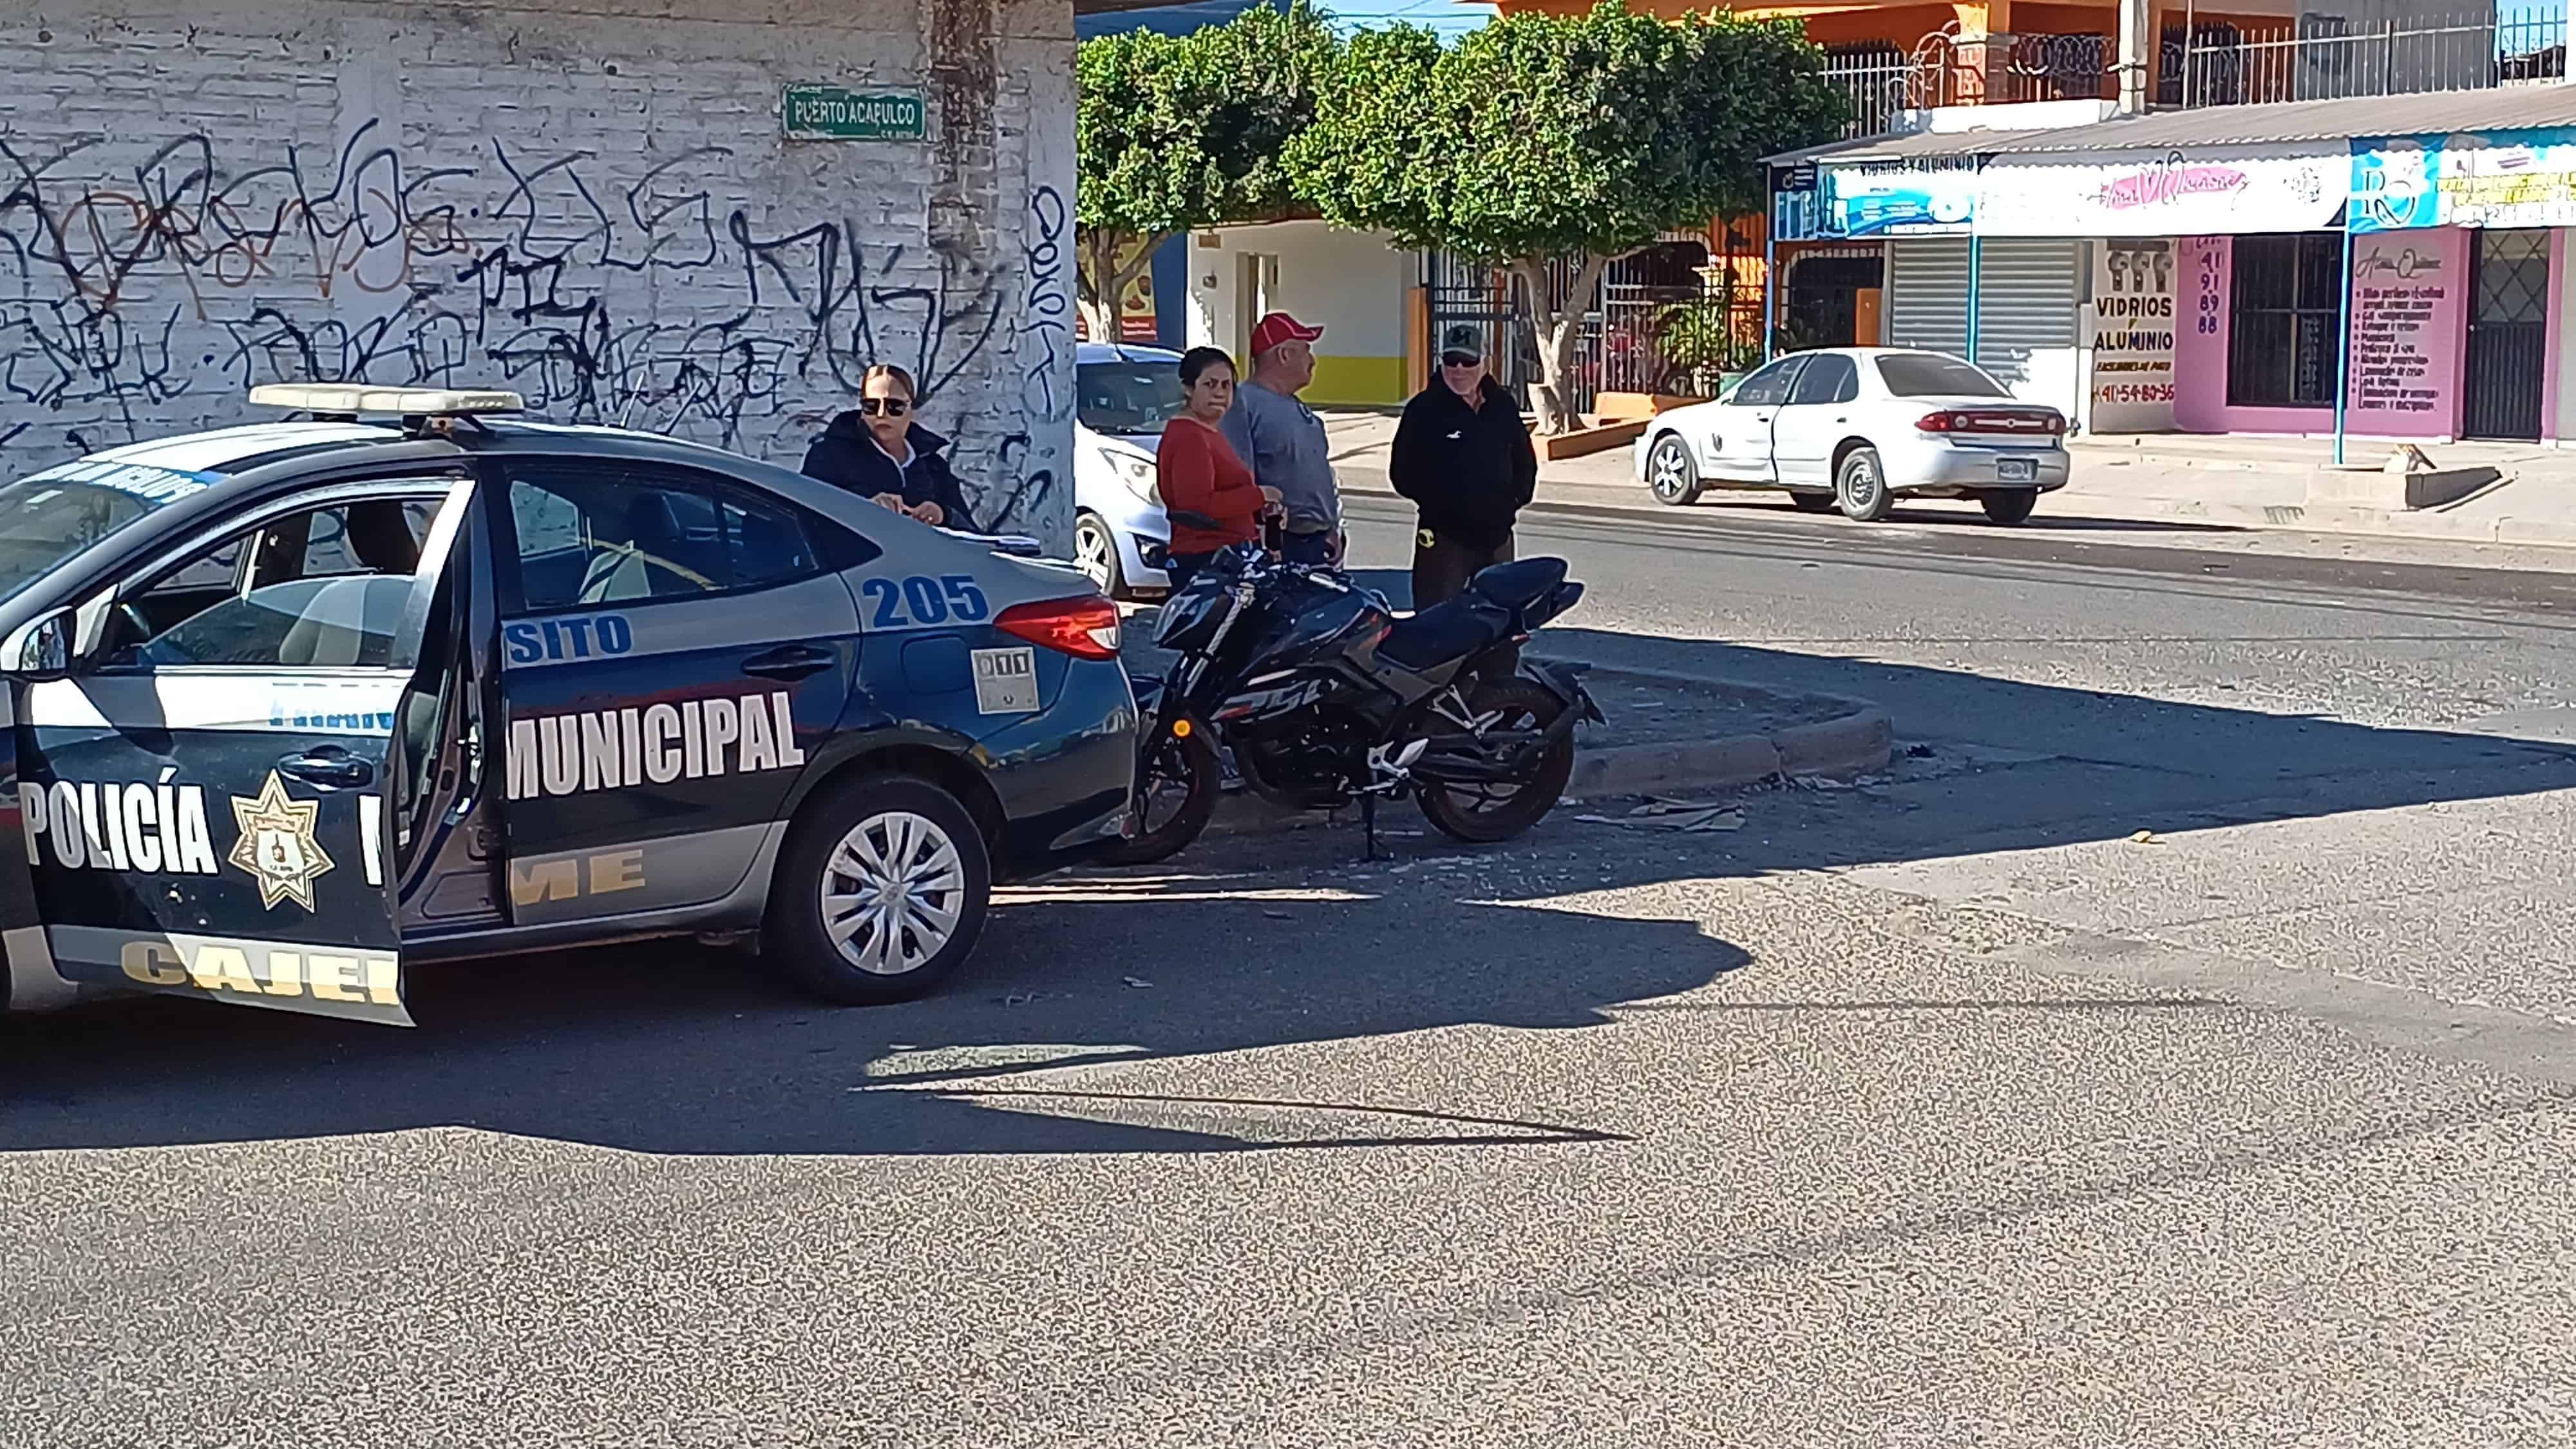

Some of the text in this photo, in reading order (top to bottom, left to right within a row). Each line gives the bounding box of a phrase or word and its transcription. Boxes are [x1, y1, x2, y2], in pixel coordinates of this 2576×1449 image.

[795, 101, 846, 124] PUERTO
[2097, 297, 2172, 317] VIDRIOS
[2093, 331, 2174, 351] ALUMINIO
[862, 575, 989, 628] 205
[504, 615, 632, 663] SITO
[17, 766, 218, 875] POLICÍA
